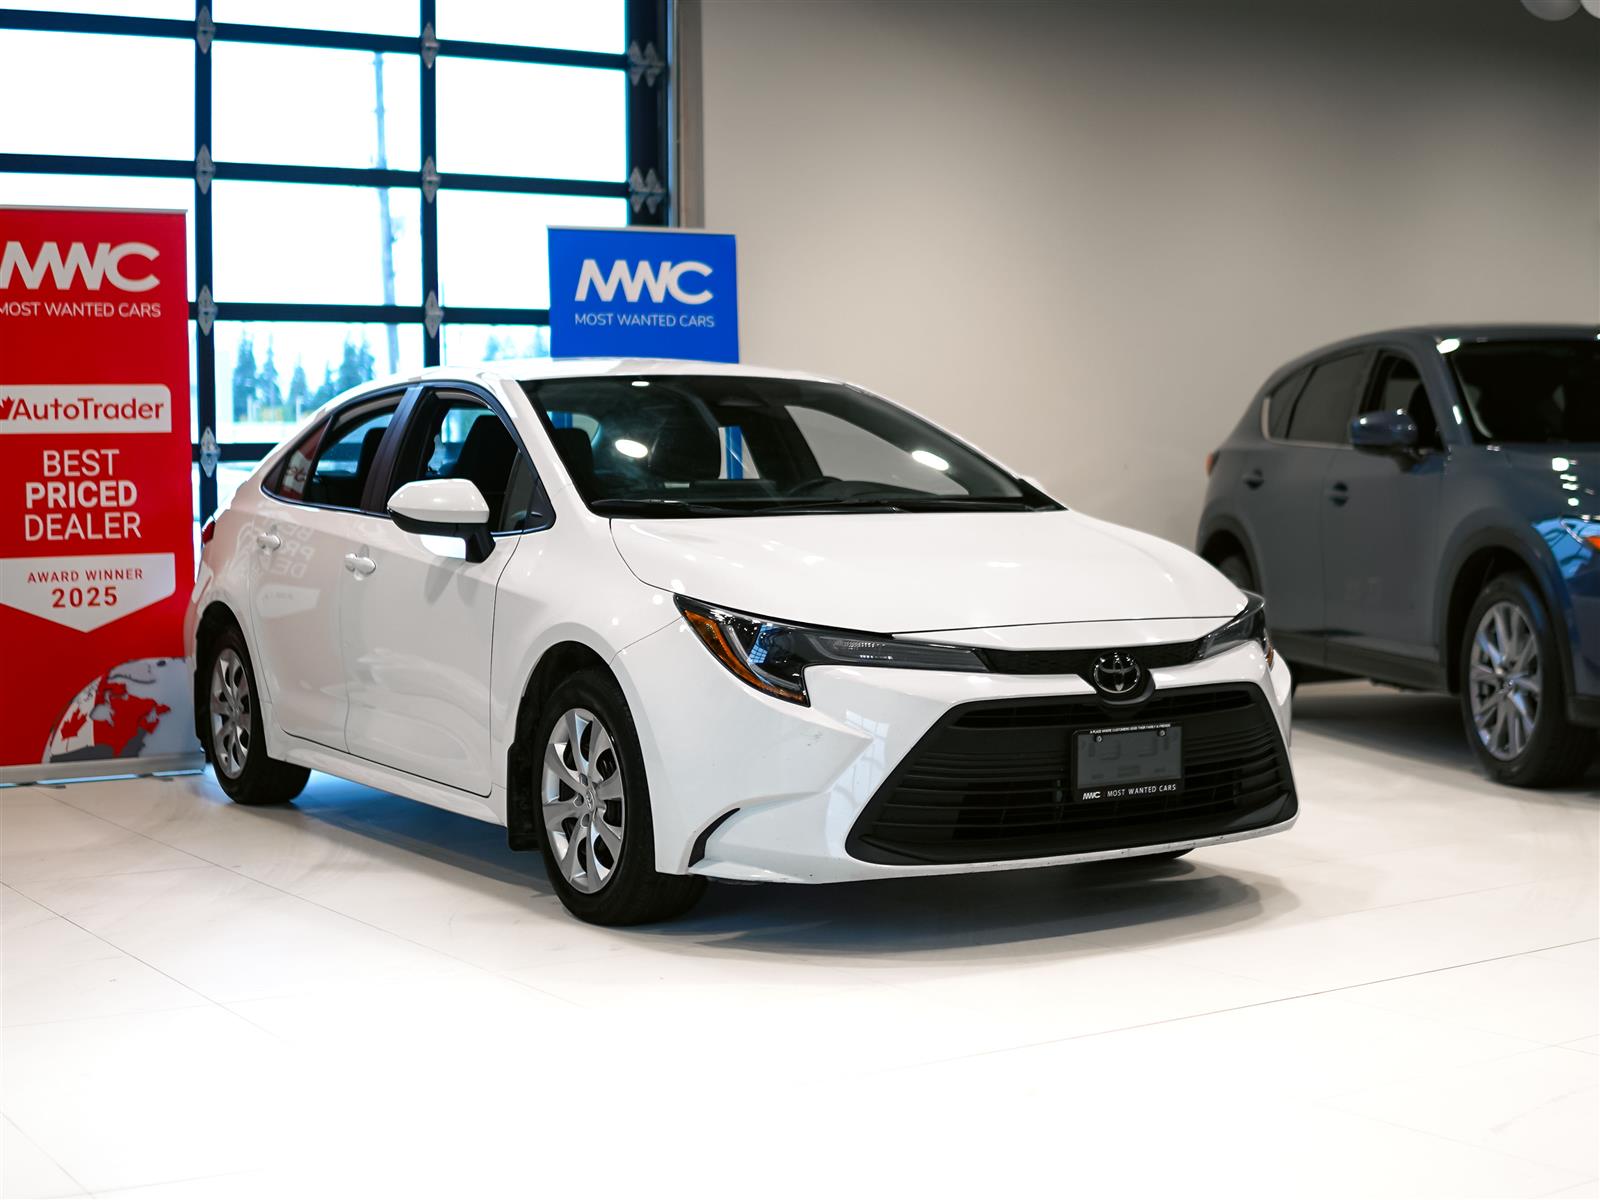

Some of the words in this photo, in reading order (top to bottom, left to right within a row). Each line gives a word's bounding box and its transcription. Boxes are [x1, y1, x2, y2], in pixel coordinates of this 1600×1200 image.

[0, 240, 161, 292] MWC
[574, 258, 714, 305] MWC
[0, 301, 41, 317] MOST
[44, 302, 115, 318] WANTED
[118, 302, 161, 318] CARS
[574, 313, 614, 326] MOST
[616, 314, 676, 328] WANTED
[679, 314, 715, 328] CARS
[12, 397, 164, 420] AutoTrader
[43, 449, 120, 477] BEST
[25, 480, 138, 509] PRICED
[24, 511, 142, 541] DEALER
[27, 570, 79, 584] AWARD
[85, 567, 144, 581] WINNER
[51, 586, 118, 609] 2025
[1106, 789, 1126, 798] MOST
[1128, 785, 1157, 795] WANTED
[1159, 783, 1177, 792] CARS
